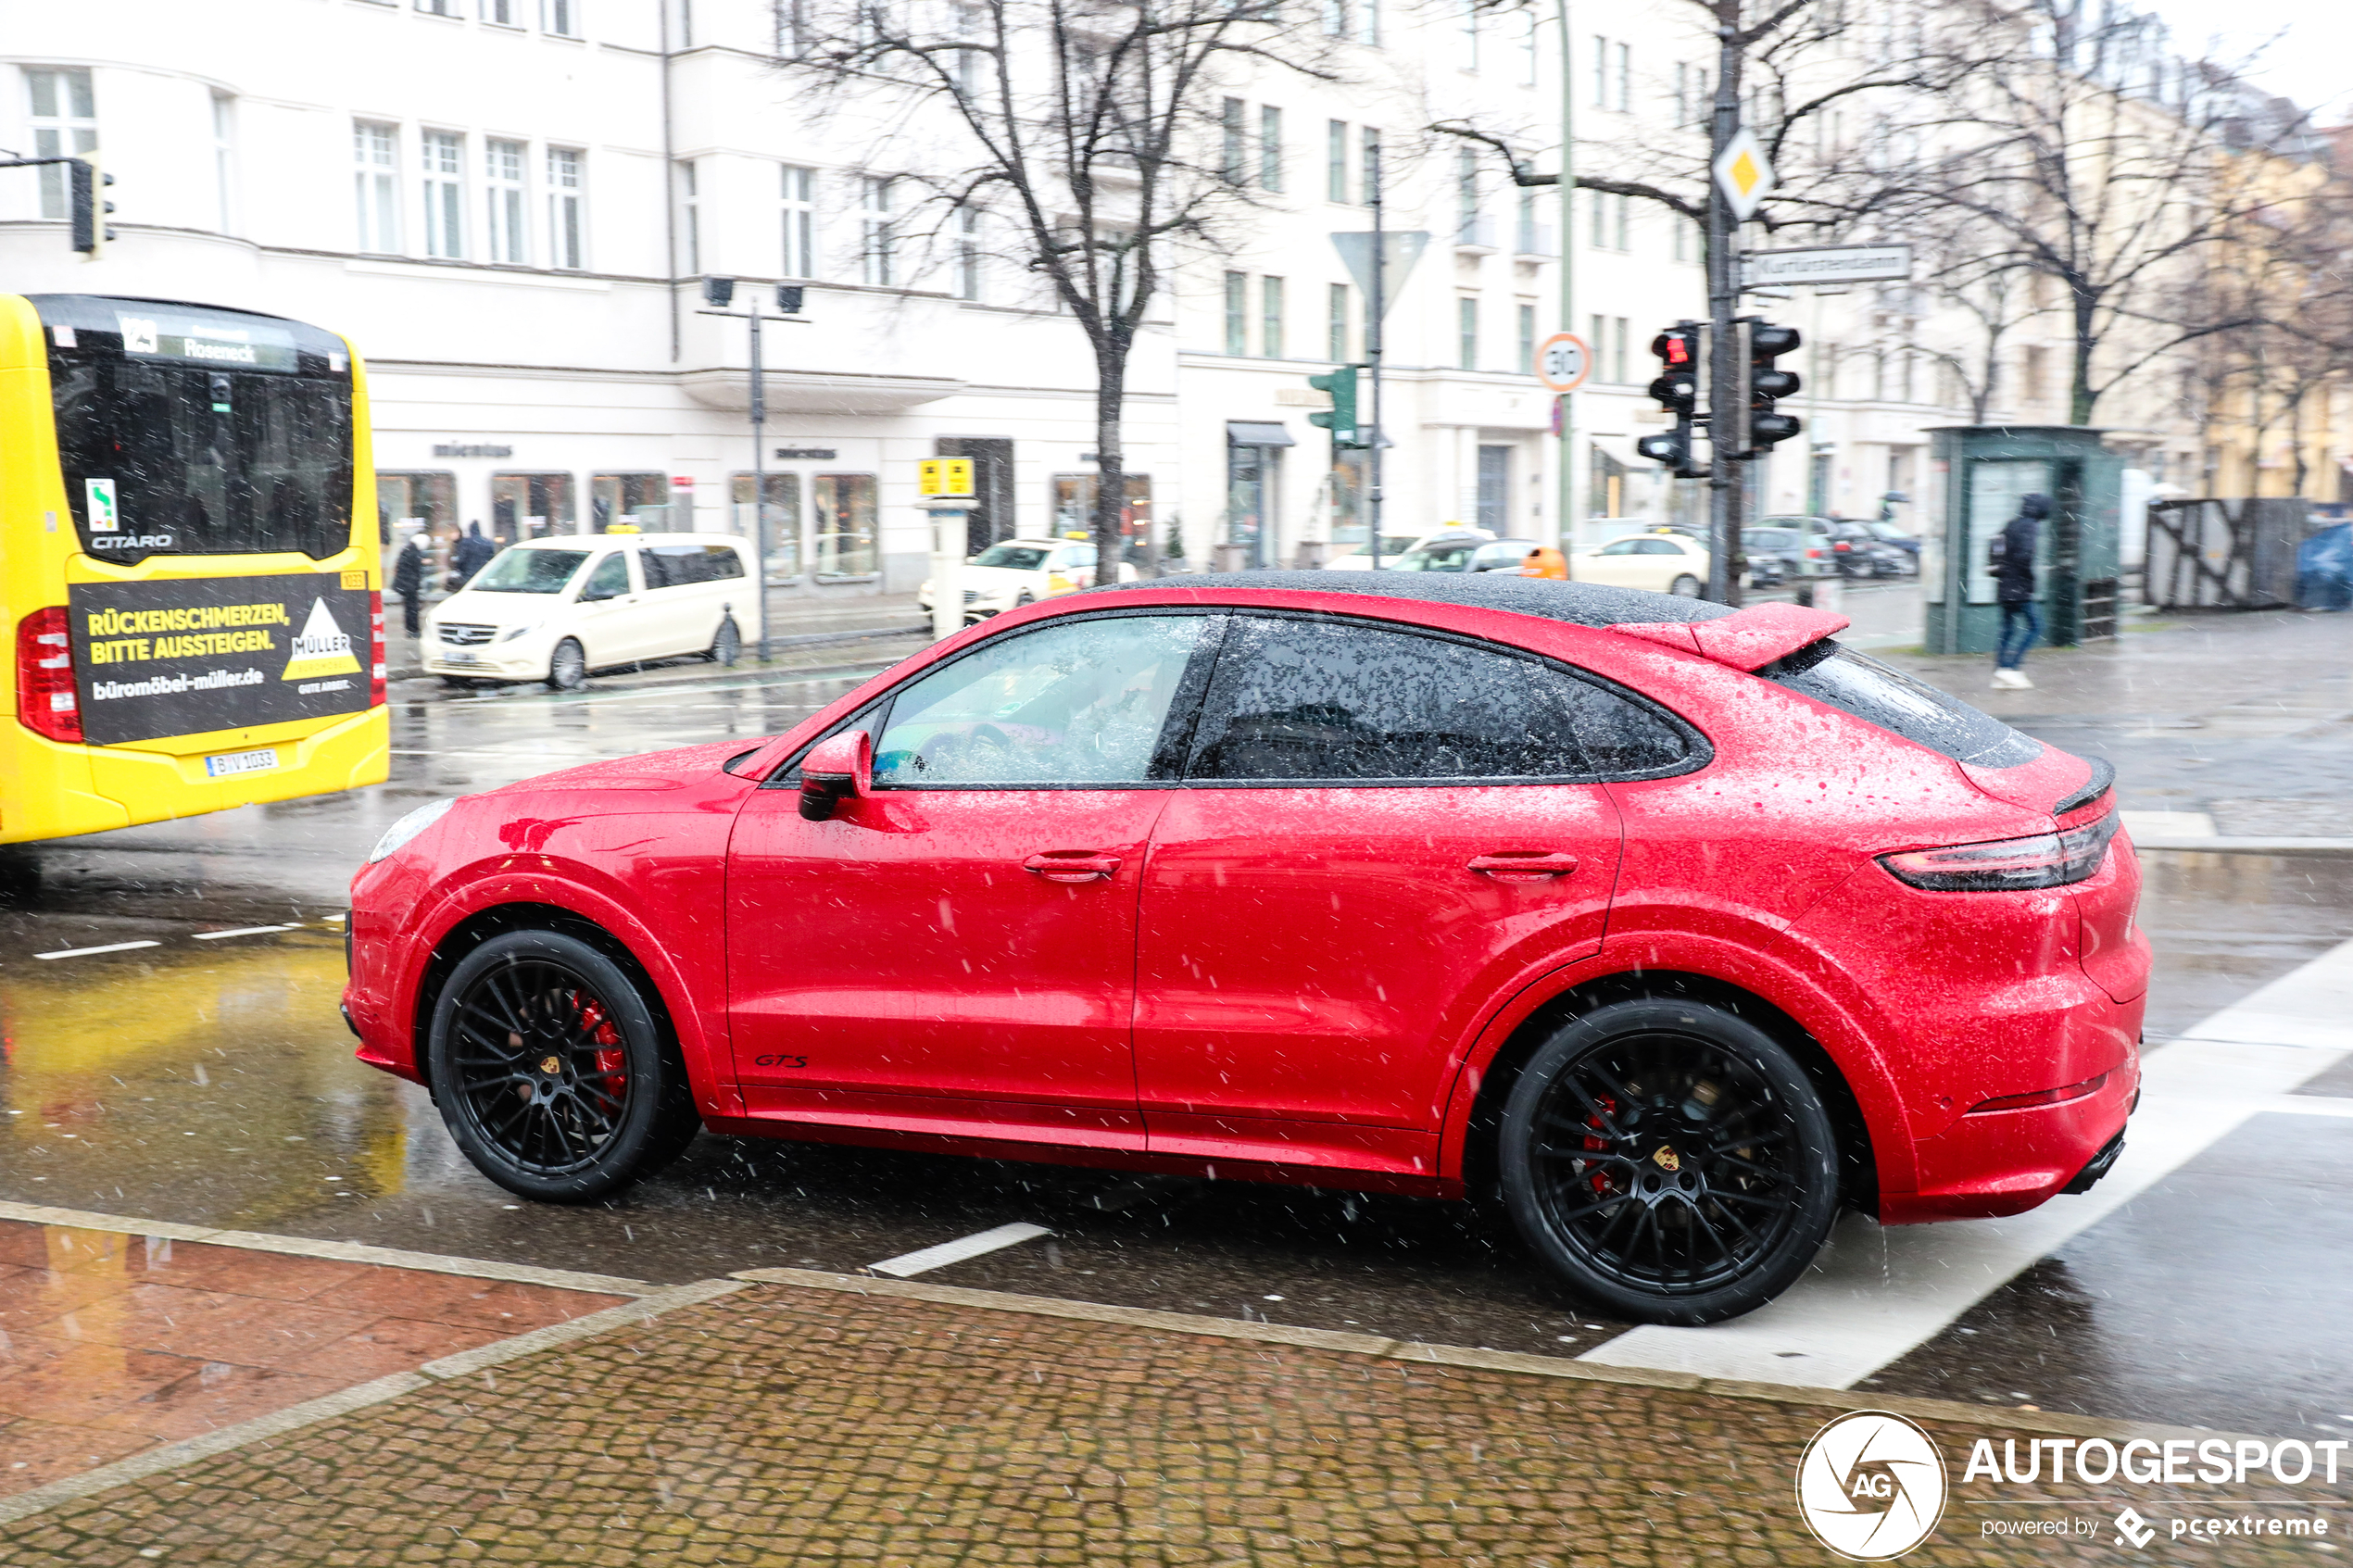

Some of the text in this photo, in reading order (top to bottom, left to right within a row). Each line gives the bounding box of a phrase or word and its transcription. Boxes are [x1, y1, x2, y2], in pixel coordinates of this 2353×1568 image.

[184, 338, 257, 363] Roseneck
[1545, 350, 1581, 375] 30
[92, 534, 173, 549] CITARO
[88, 603, 291, 636] RÜCKENSCHMERZEN,
[90, 630, 276, 664] BITTE AUSSTEIGEN.
[292, 635, 350, 656] MÜLLER
[93, 668, 264, 701] büromöbel-müller.de
[298, 683, 321, 695] GUTE
[217, 758, 226, 772] B
[244, 751, 272, 769] 1033
[755, 1054, 808, 1068] GTS
